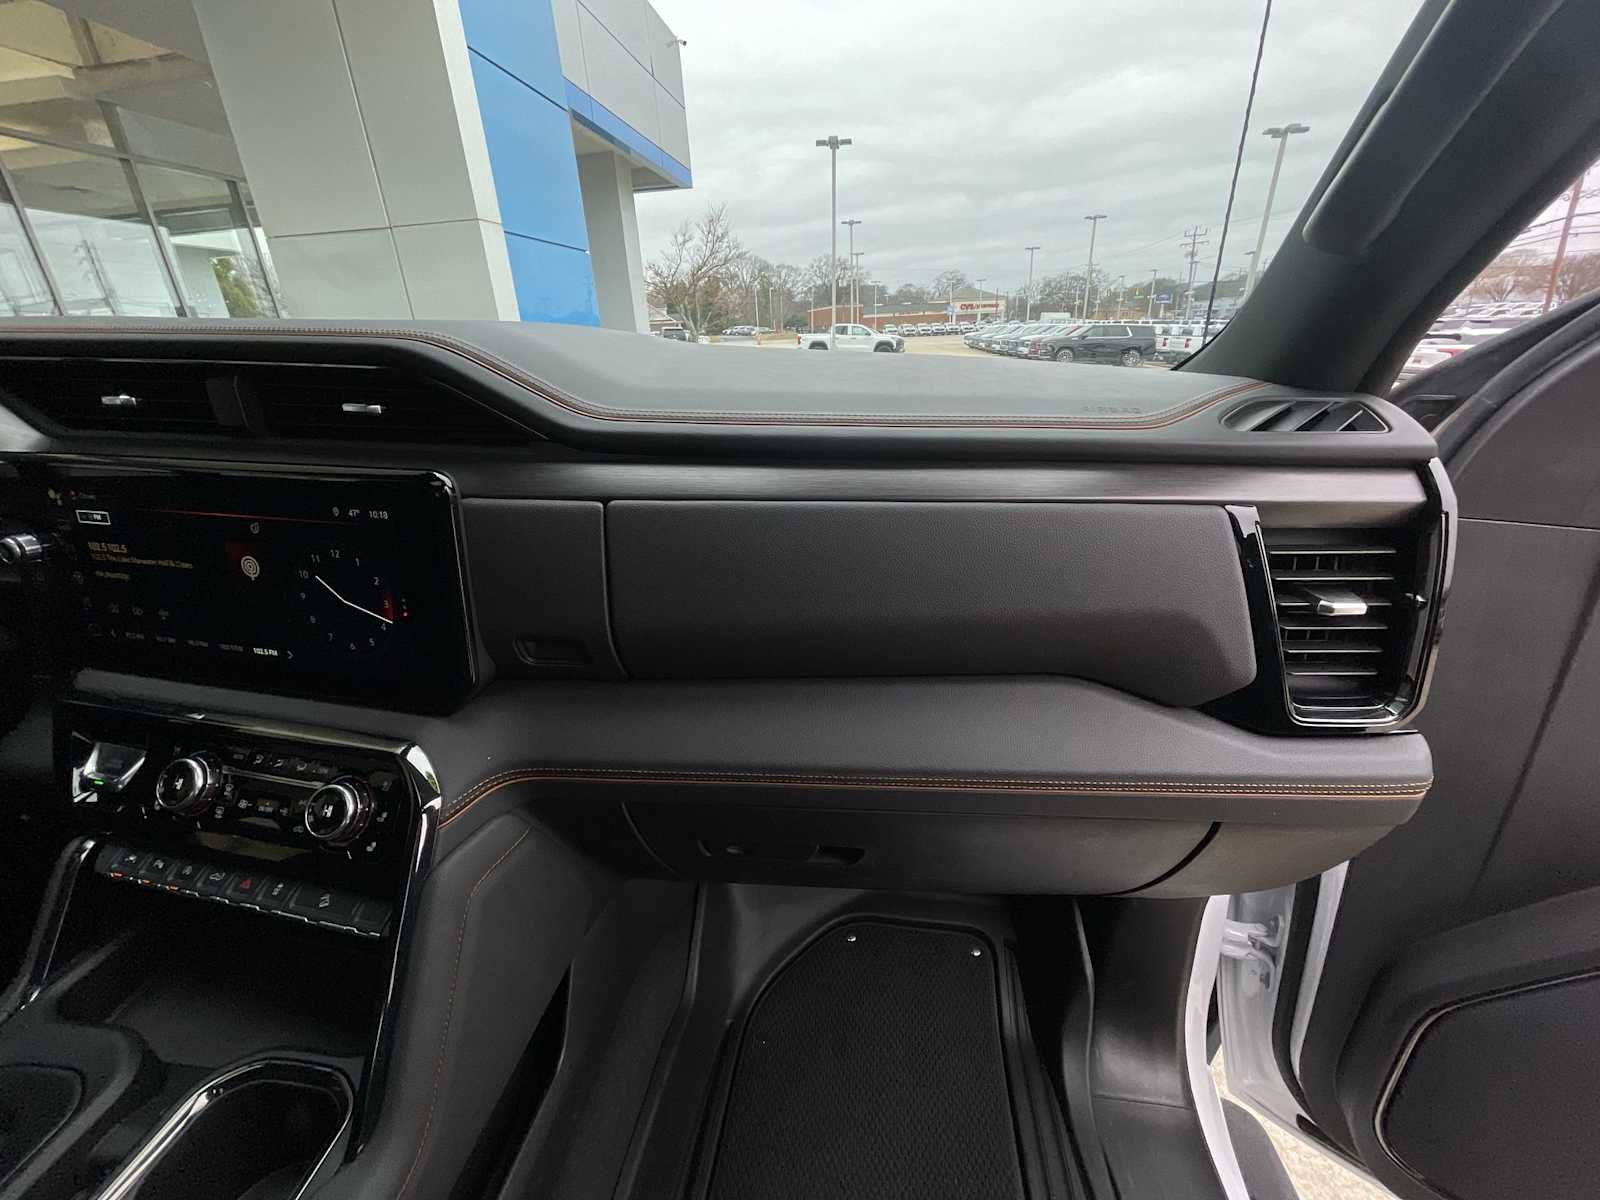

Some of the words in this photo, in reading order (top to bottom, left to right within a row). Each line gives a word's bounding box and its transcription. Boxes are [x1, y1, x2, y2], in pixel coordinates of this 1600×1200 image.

[368, 510, 388, 520] 10:18
[310, 553, 320, 563] 11
[329, 549, 340, 559] 12
[298, 570, 309, 580] 10
[373, 576, 380, 586] 2
[300, 592, 306, 600] 9
[369, 637, 375, 646] 5
[252, 647, 268, 656] 102.5
[268, 648, 279, 657] FM
